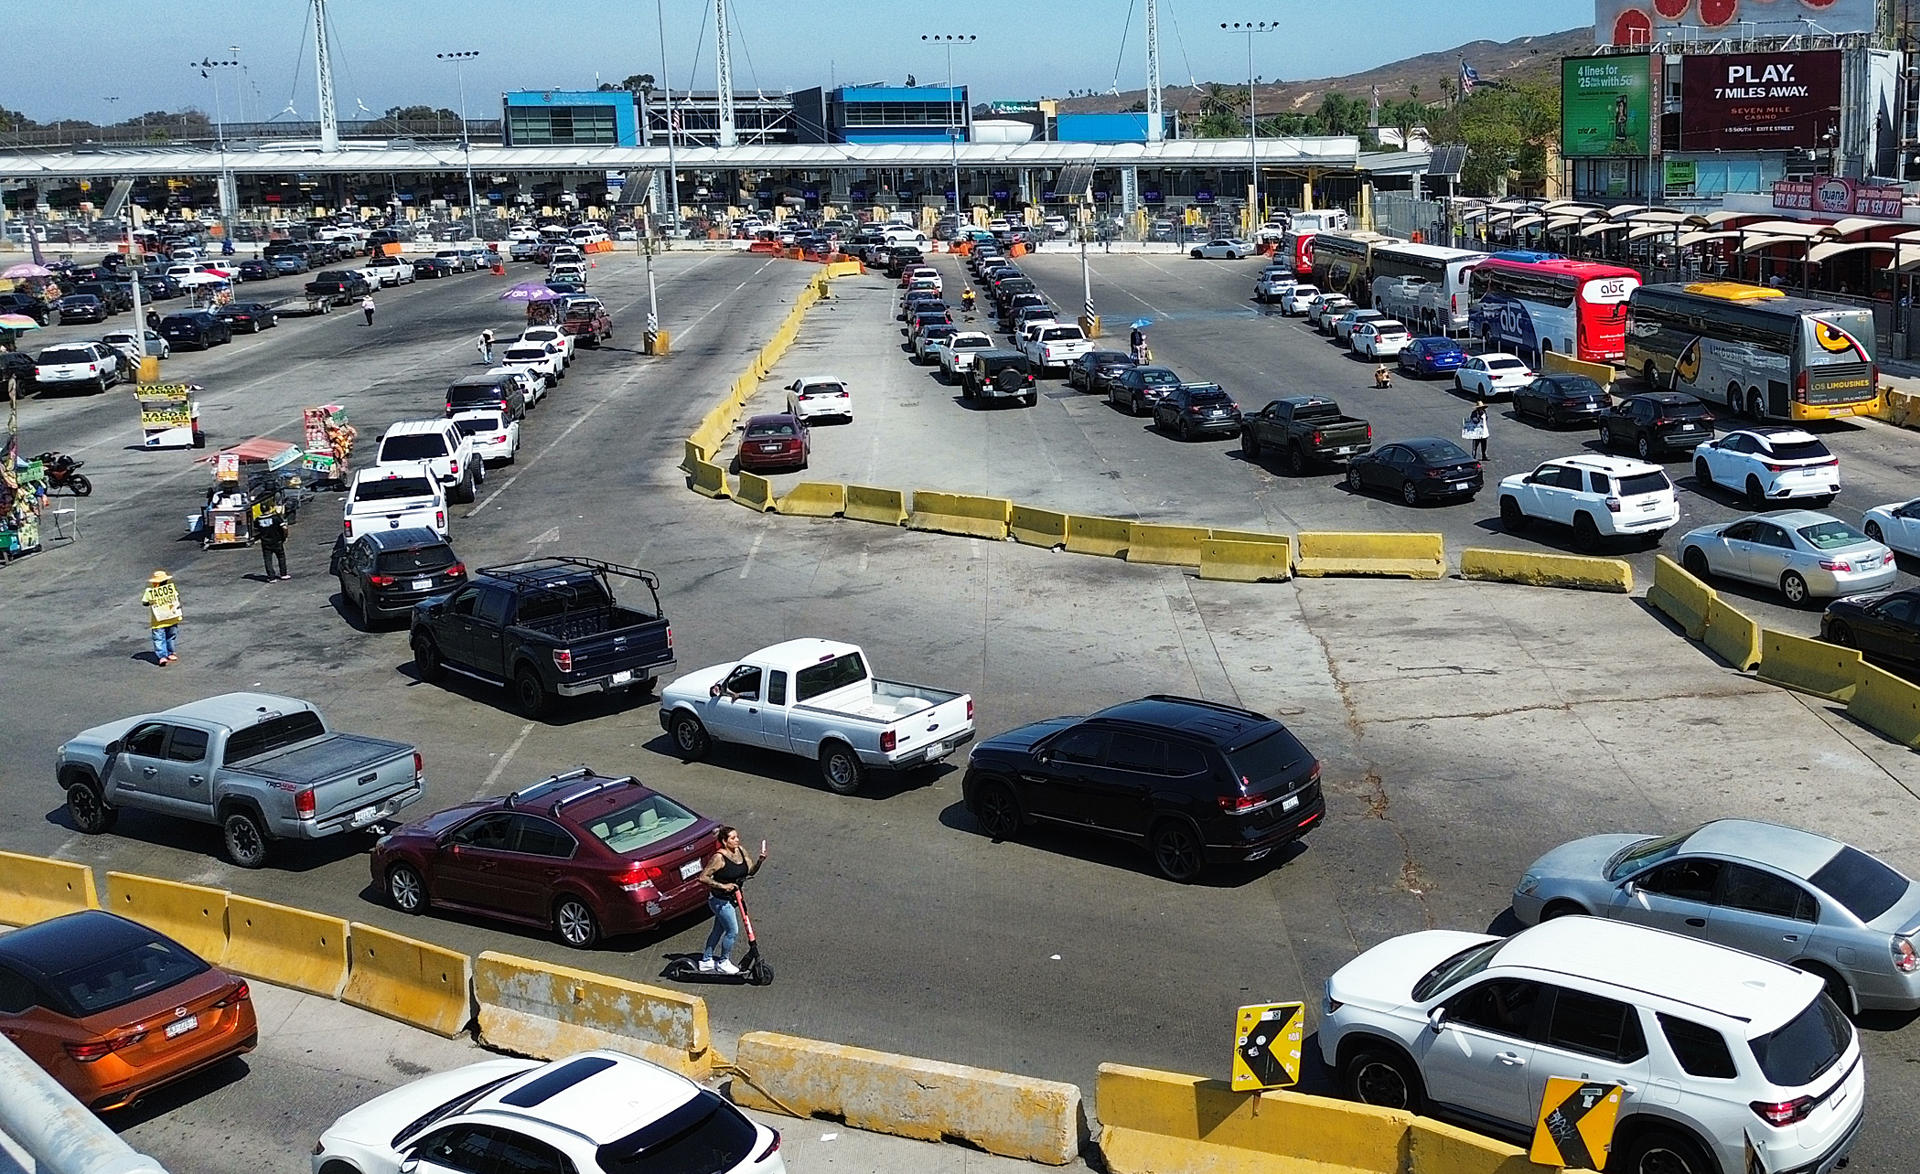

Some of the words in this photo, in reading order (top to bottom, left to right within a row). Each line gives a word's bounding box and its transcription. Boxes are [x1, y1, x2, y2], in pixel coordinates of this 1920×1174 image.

[1578, 66, 1583, 76] 4
[1585, 66, 1604, 76] lines
[1605, 64, 1618, 75] for
[1728, 64, 1796, 83] PLAY.
[1601, 76, 1619, 87] with
[1714, 88, 1723, 99] 7
[1725, 87, 1765, 99] MILES
[1768, 86, 1809, 97] AWAY.
[1600, 281, 1624, 294] abc
[1500, 301, 1523, 335] abc
[1811, 383, 1825, 391] LOS
[1826, 379, 1869, 390] LIMOUSINES
[149, 585, 173, 599] TACOS
